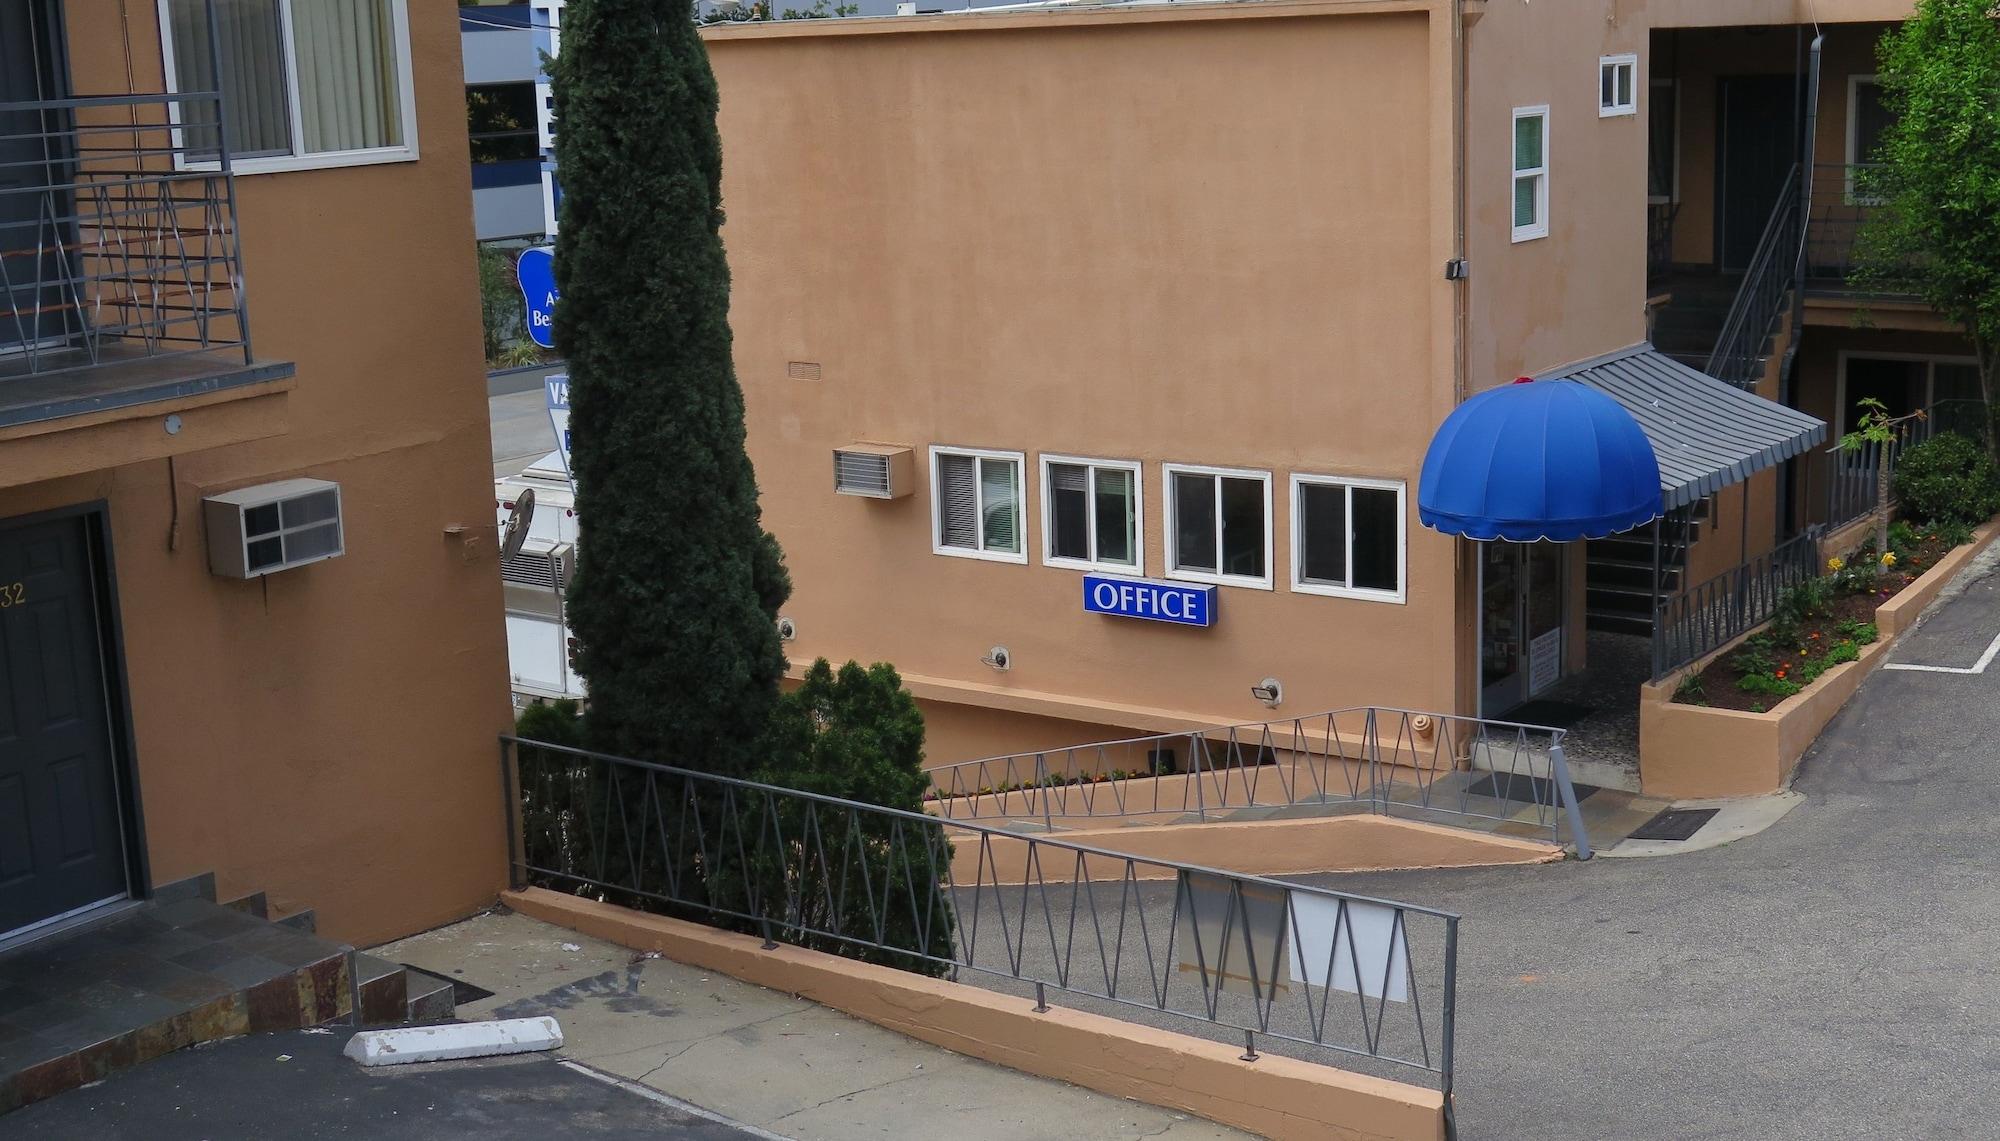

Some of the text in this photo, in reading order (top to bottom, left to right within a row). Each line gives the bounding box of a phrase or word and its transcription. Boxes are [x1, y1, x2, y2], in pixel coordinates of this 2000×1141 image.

[533, 309, 552, 326] Be
[0, 582, 25, 607] 32
[1093, 583, 1197, 619] OFFICE
